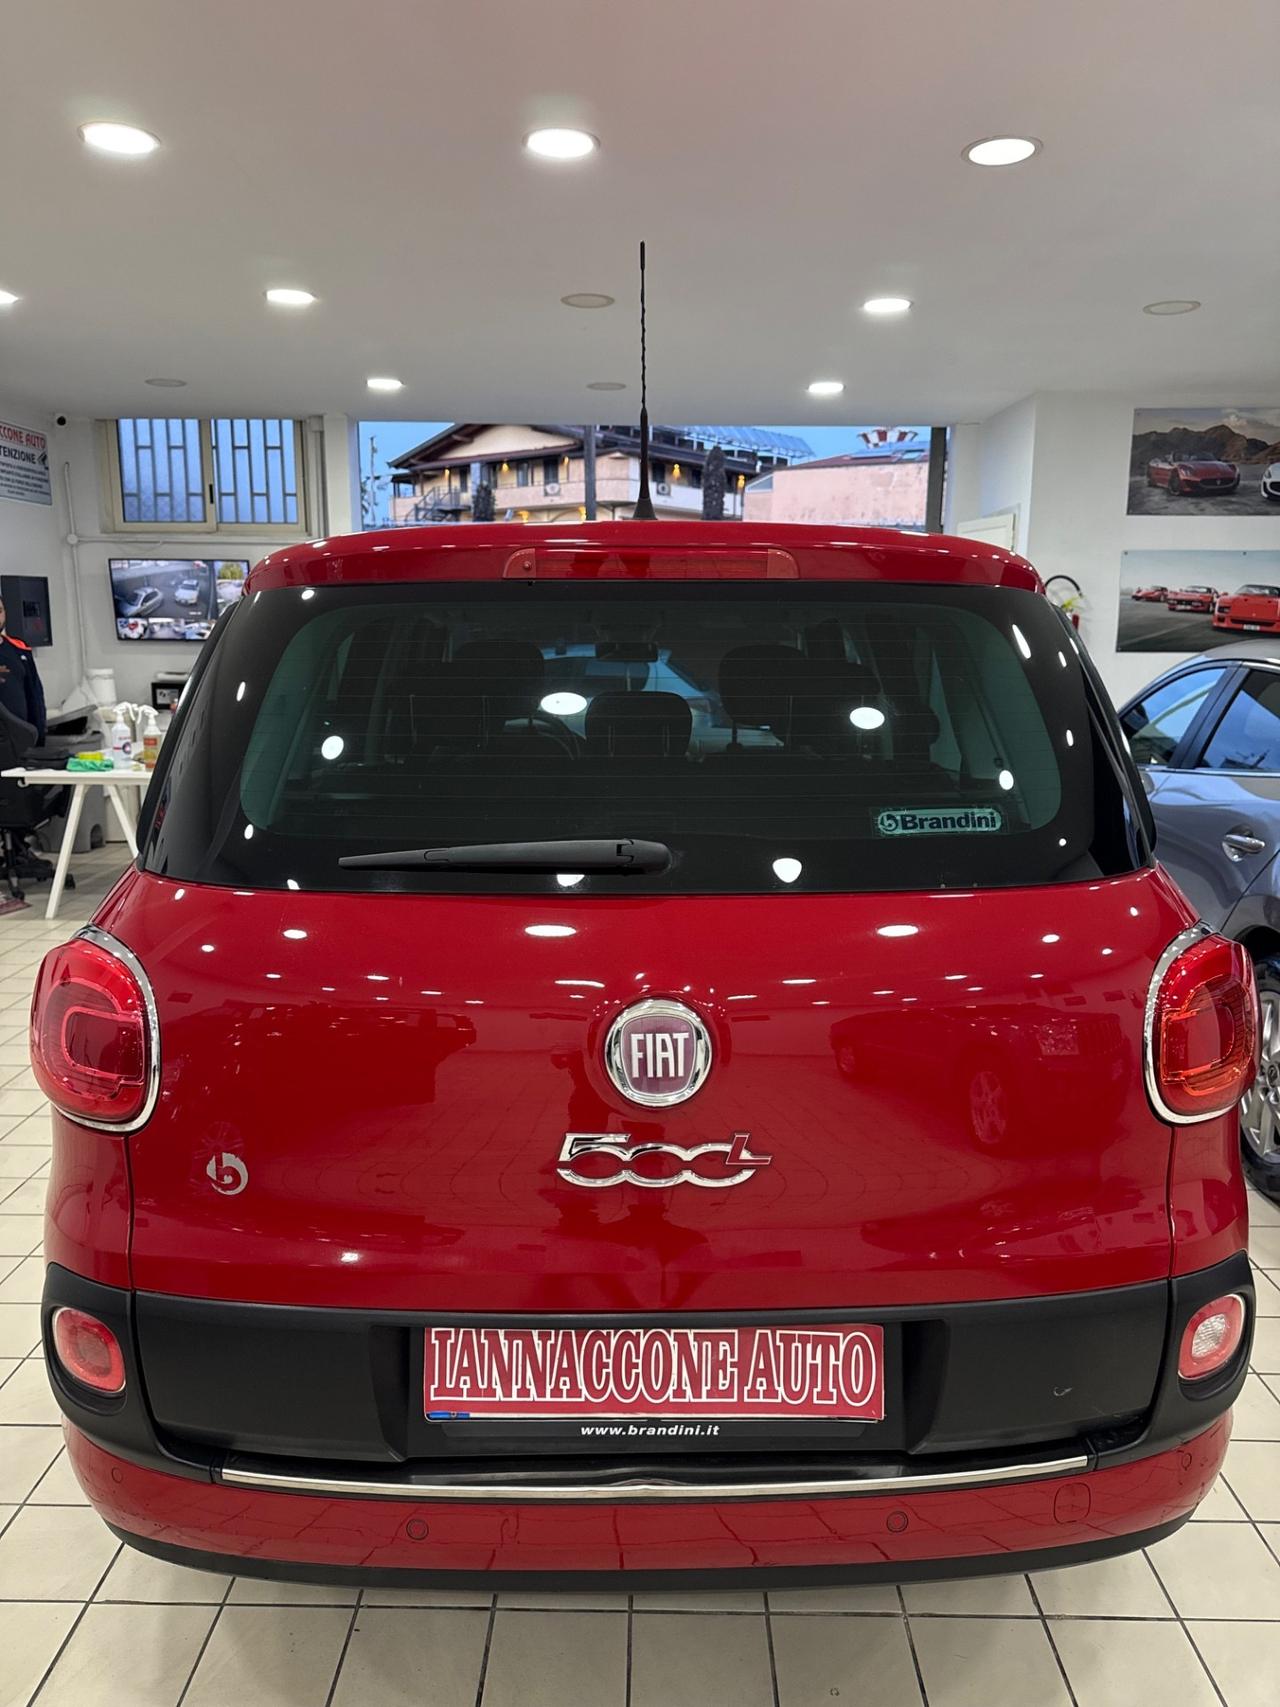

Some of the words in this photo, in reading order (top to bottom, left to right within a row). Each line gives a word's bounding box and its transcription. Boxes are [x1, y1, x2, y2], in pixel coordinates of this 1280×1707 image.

[25, 433, 46, 449] AUTO
[901, 811, 996, 830] Brandini
[630, 1032, 689, 1078] FIAT
[556, 1132, 772, 1188] 500L
[430, 1328, 738, 1403] IANNACCONE
[744, 1329, 877, 1406] AUTO
[580, 1424, 720, 1436] www.brandini.it
